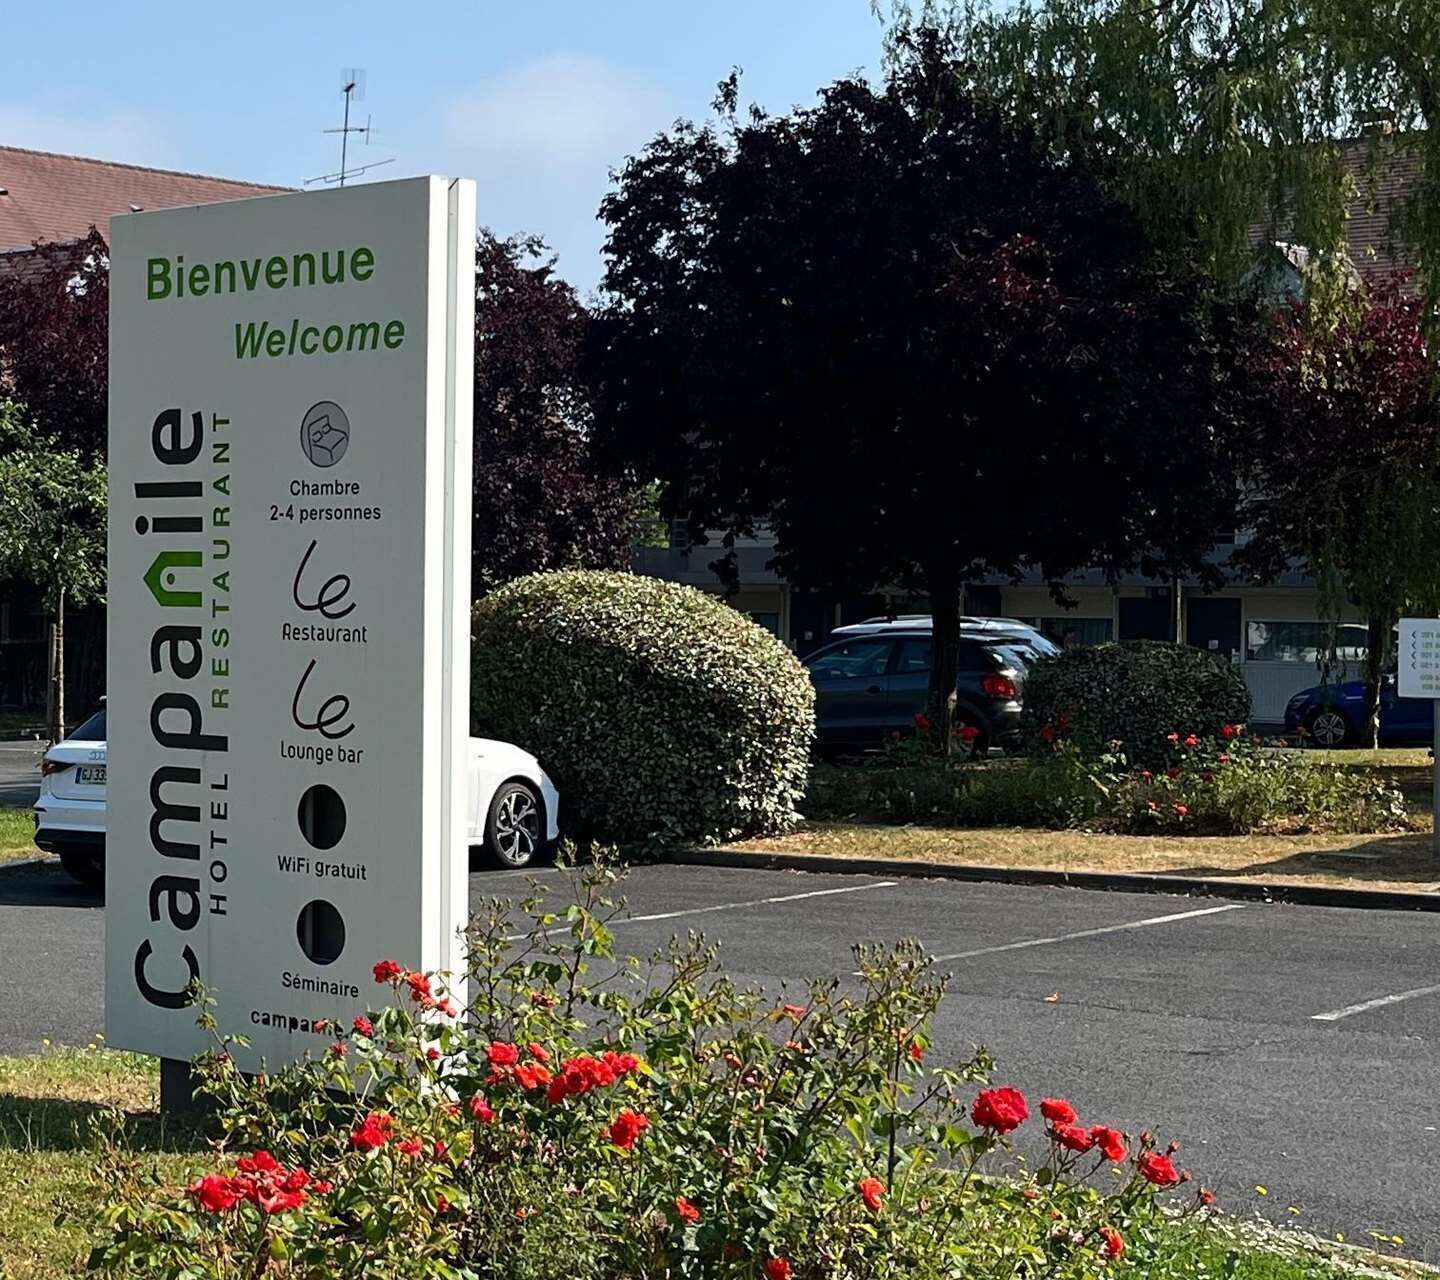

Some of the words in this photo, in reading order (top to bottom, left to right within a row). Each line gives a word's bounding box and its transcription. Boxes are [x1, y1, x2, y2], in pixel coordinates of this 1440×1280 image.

[147, 247, 375, 300] Bienvenue
[235, 319, 405, 359] Welcome
[290, 480, 360, 496] Chambre
[270, 504, 294, 521] 2-4
[300, 507, 381, 524] personnes
[212, 413, 230, 709] RESTAURANT
[282, 622, 368, 643] Restaurant
[134, 408, 229, 1010] Campanile
[281, 740, 334, 765] Lounge
[338, 745, 364, 763] bar
[210, 773, 228, 916] HOTEL
[277, 855, 310, 874] WiFi
[314, 861, 367, 881] gratuit
[282, 971, 360, 998] Séminaire
